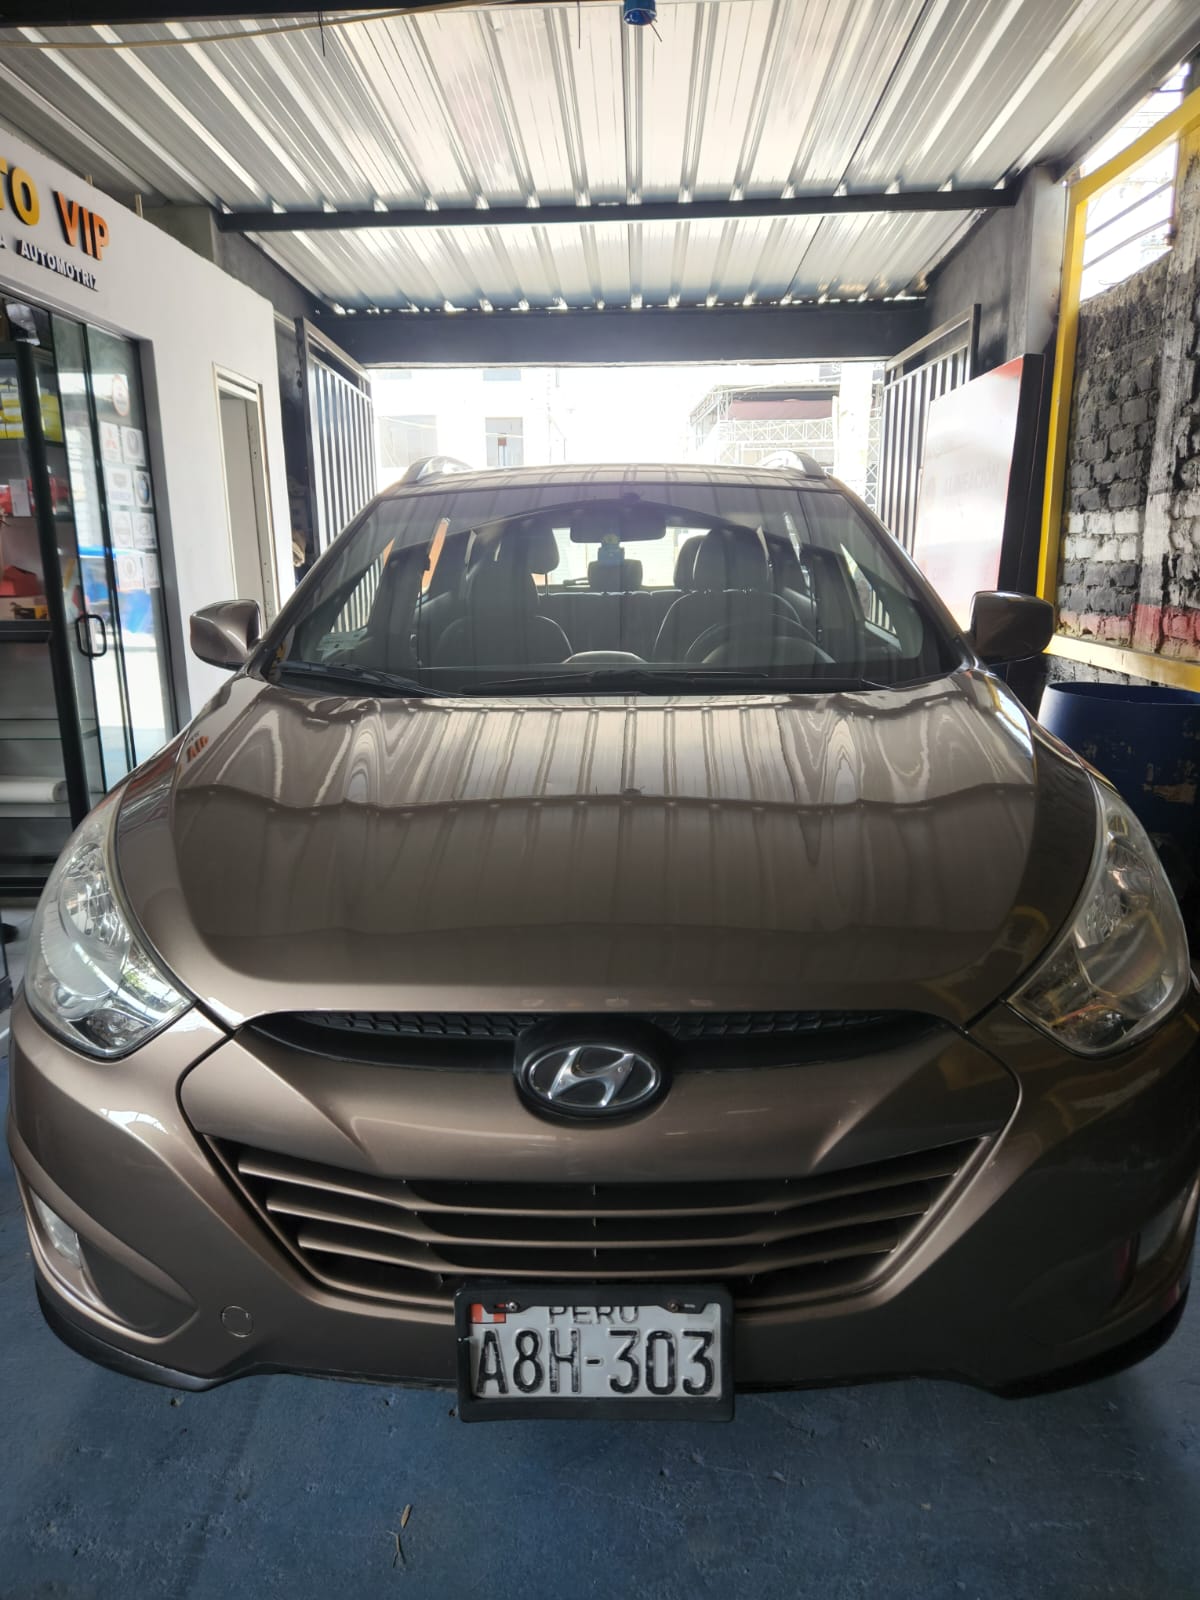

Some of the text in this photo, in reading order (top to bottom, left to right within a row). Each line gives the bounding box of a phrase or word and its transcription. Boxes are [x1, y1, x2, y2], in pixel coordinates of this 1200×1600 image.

[53, 191, 109, 261] VIP
[18, 239, 97, 291] AUTOMOTRIZ
[476, 1328, 715, 1395] A8H-303
